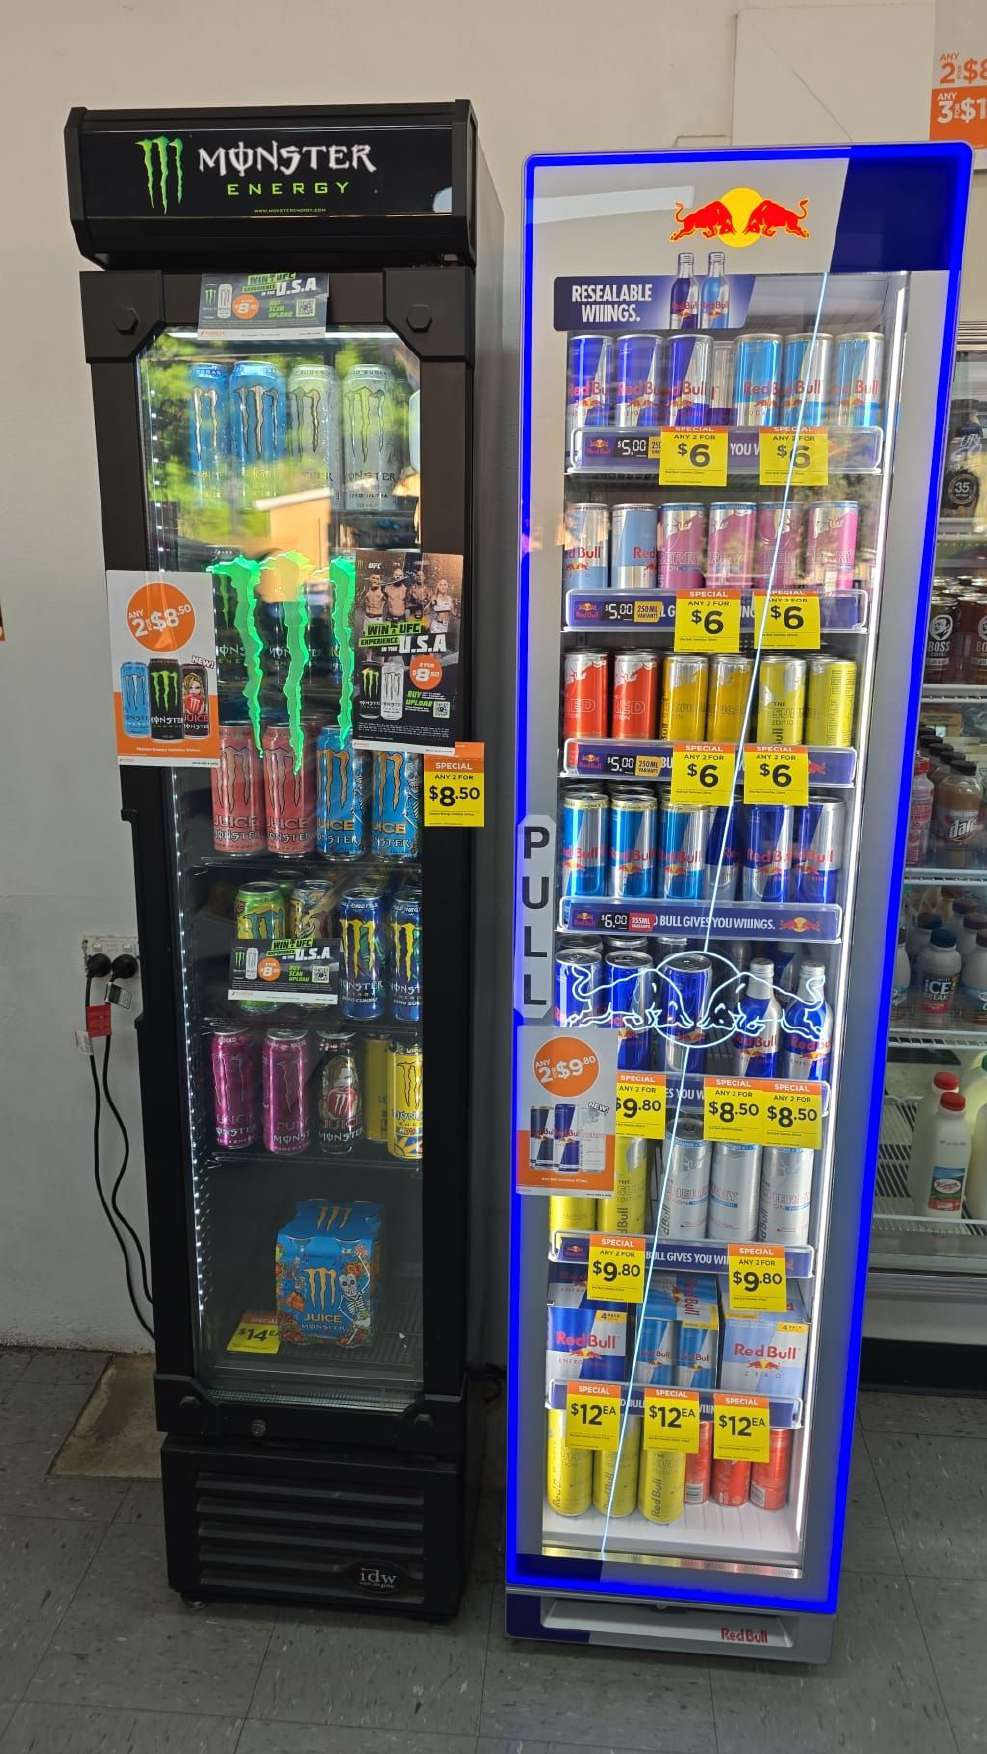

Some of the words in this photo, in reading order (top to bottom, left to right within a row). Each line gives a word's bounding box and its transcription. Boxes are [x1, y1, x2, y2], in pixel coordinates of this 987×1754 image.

[940, 52, 960, 61] ANY
[940, 62, 955, 83] 2
[938, 92, 957, 100] ANY
[937, 101, 953, 123] 3
[198, 140, 377, 177] MONSTER
[227, 182, 349, 195] ENERGY
[572, 284, 653, 302] RESEALABLE
[617, 440, 646, 456] $5.00
[677, 442, 710, 467] $6
[730, 444, 753, 456] YOU
[777, 445, 811, 468] $6
[954, 482, 970, 493] 35
[634, 546, 657, 558] Red
[128, 609, 143, 619] ANY
[605, 604, 633, 619] $5.00
[770, 605, 804, 629] $6
[132, 618, 148, 637] 2
[151, 604, 192, 632] $8.50
[691, 609, 724, 634] $6
[367, 624, 389, 635] WIN
[399, 623, 420, 633] UFC
[360, 637, 398, 646] EXPERIENCE
[399, 634, 447, 654] U.S.A
[928, 641, 951, 652] BOSS
[192, 655, 216, 669] NEW!
[435, 762, 472, 770] SPECIAL
[608, 757, 634, 772] $5.00
[687, 763, 719, 787] $6
[760, 763, 792, 787] $6
[429, 785, 480, 807] $8.50
[214, 816, 257, 829] JUICE
[267, 816, 310, 829] JUICE
[522, 826, 551, 1006] PULL
[601, 914, 628, 928] $6.00
[660, 916, 682, 927] BULL
[684, 917, 711, 928] GIVES
[712, 917, 733, 928] YOU
[295, 947, 331, 961] U.S.A
[754, 1033, 776, 1048] Bull
[535, 1059, 550, 1068] ANY
[538, 1066, 553, 1083] 2
[620, 1074, 655, 1082] SPECIAL
[641, 1086, 656, 1094] FOR
[716, 1079, 751, 1088] SPECIAL
[774, 1083, 810, 1093] SPECIAL
[587, 1101, 610, 1116] NEW!
[709, 1101, 760, 1123] $8.50
[767, 1105, 818, 1128] $8.50
[616, 1207, 629, 1228] Bull
[601, 1238, 634, 1247] SPECIAL
[599, 1249, 614, 1257] ANY
[738, 1247, 774, 1255] SPECIAL
[667, 1253, 692, 1263] GIVES
[694, 1254, 712, 1265] YOU
[592, 1260, 640, 1282] $9.80
[732, 1271, 783, 1292] $9.80
[304, 1313, 342, 1323] JUICE
[238, 1327, 268, 1342] $14
[556, 1330, 586, 1347] Red
[588, 1334, 616, 1349] Bull
[734, 1343, 765, 1358] Red
[767, 1345, 797, 1360] Bull
[578, 1385, 610, 1395] SPECIAL
[655, 1389, 688, 1398] SPECIAL
[725, 1397, 758, 1406] SPECIAL
[571, 1402, 603, 1426] $12
[603, 1405, 617, 1416] EA
[649, 1405, 682, 1428] $12
[682, 1408, 696, 1418] EA
[718, 1414, 752, 1437] $12
[752, 1417, 766, 1427] EA
[360, 1568, 398, 1585] idw
[720, 1627, 744, 1642] Red
[745, 1629, 768, 1644] Bull
